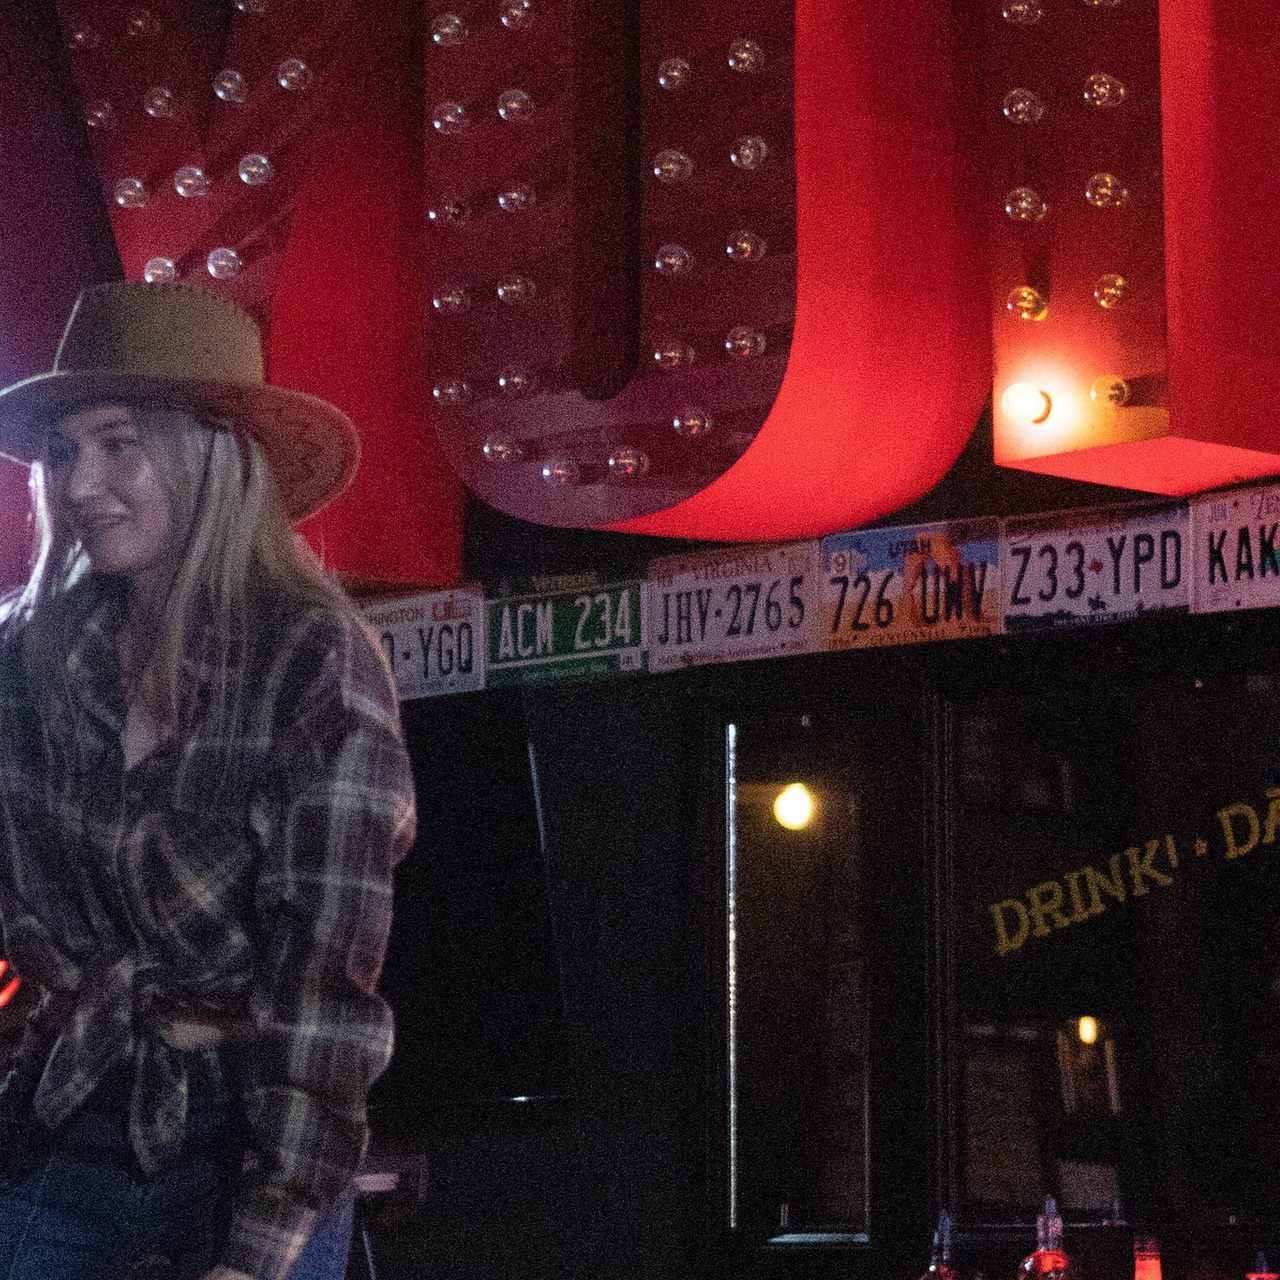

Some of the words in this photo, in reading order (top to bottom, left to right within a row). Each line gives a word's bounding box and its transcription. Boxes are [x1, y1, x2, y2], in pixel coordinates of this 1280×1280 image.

[694, 554, 772, 581] VIRGINIA
[888, 535, 933, 558] UTAH
[1011, 541, 1084, 605] Z33
[1107, 530, 1181, 595] YPD
[498, 601, 555, 660] ACM
[575, 589, 632, 650] 234
[830, 572, 894, 633] 726
